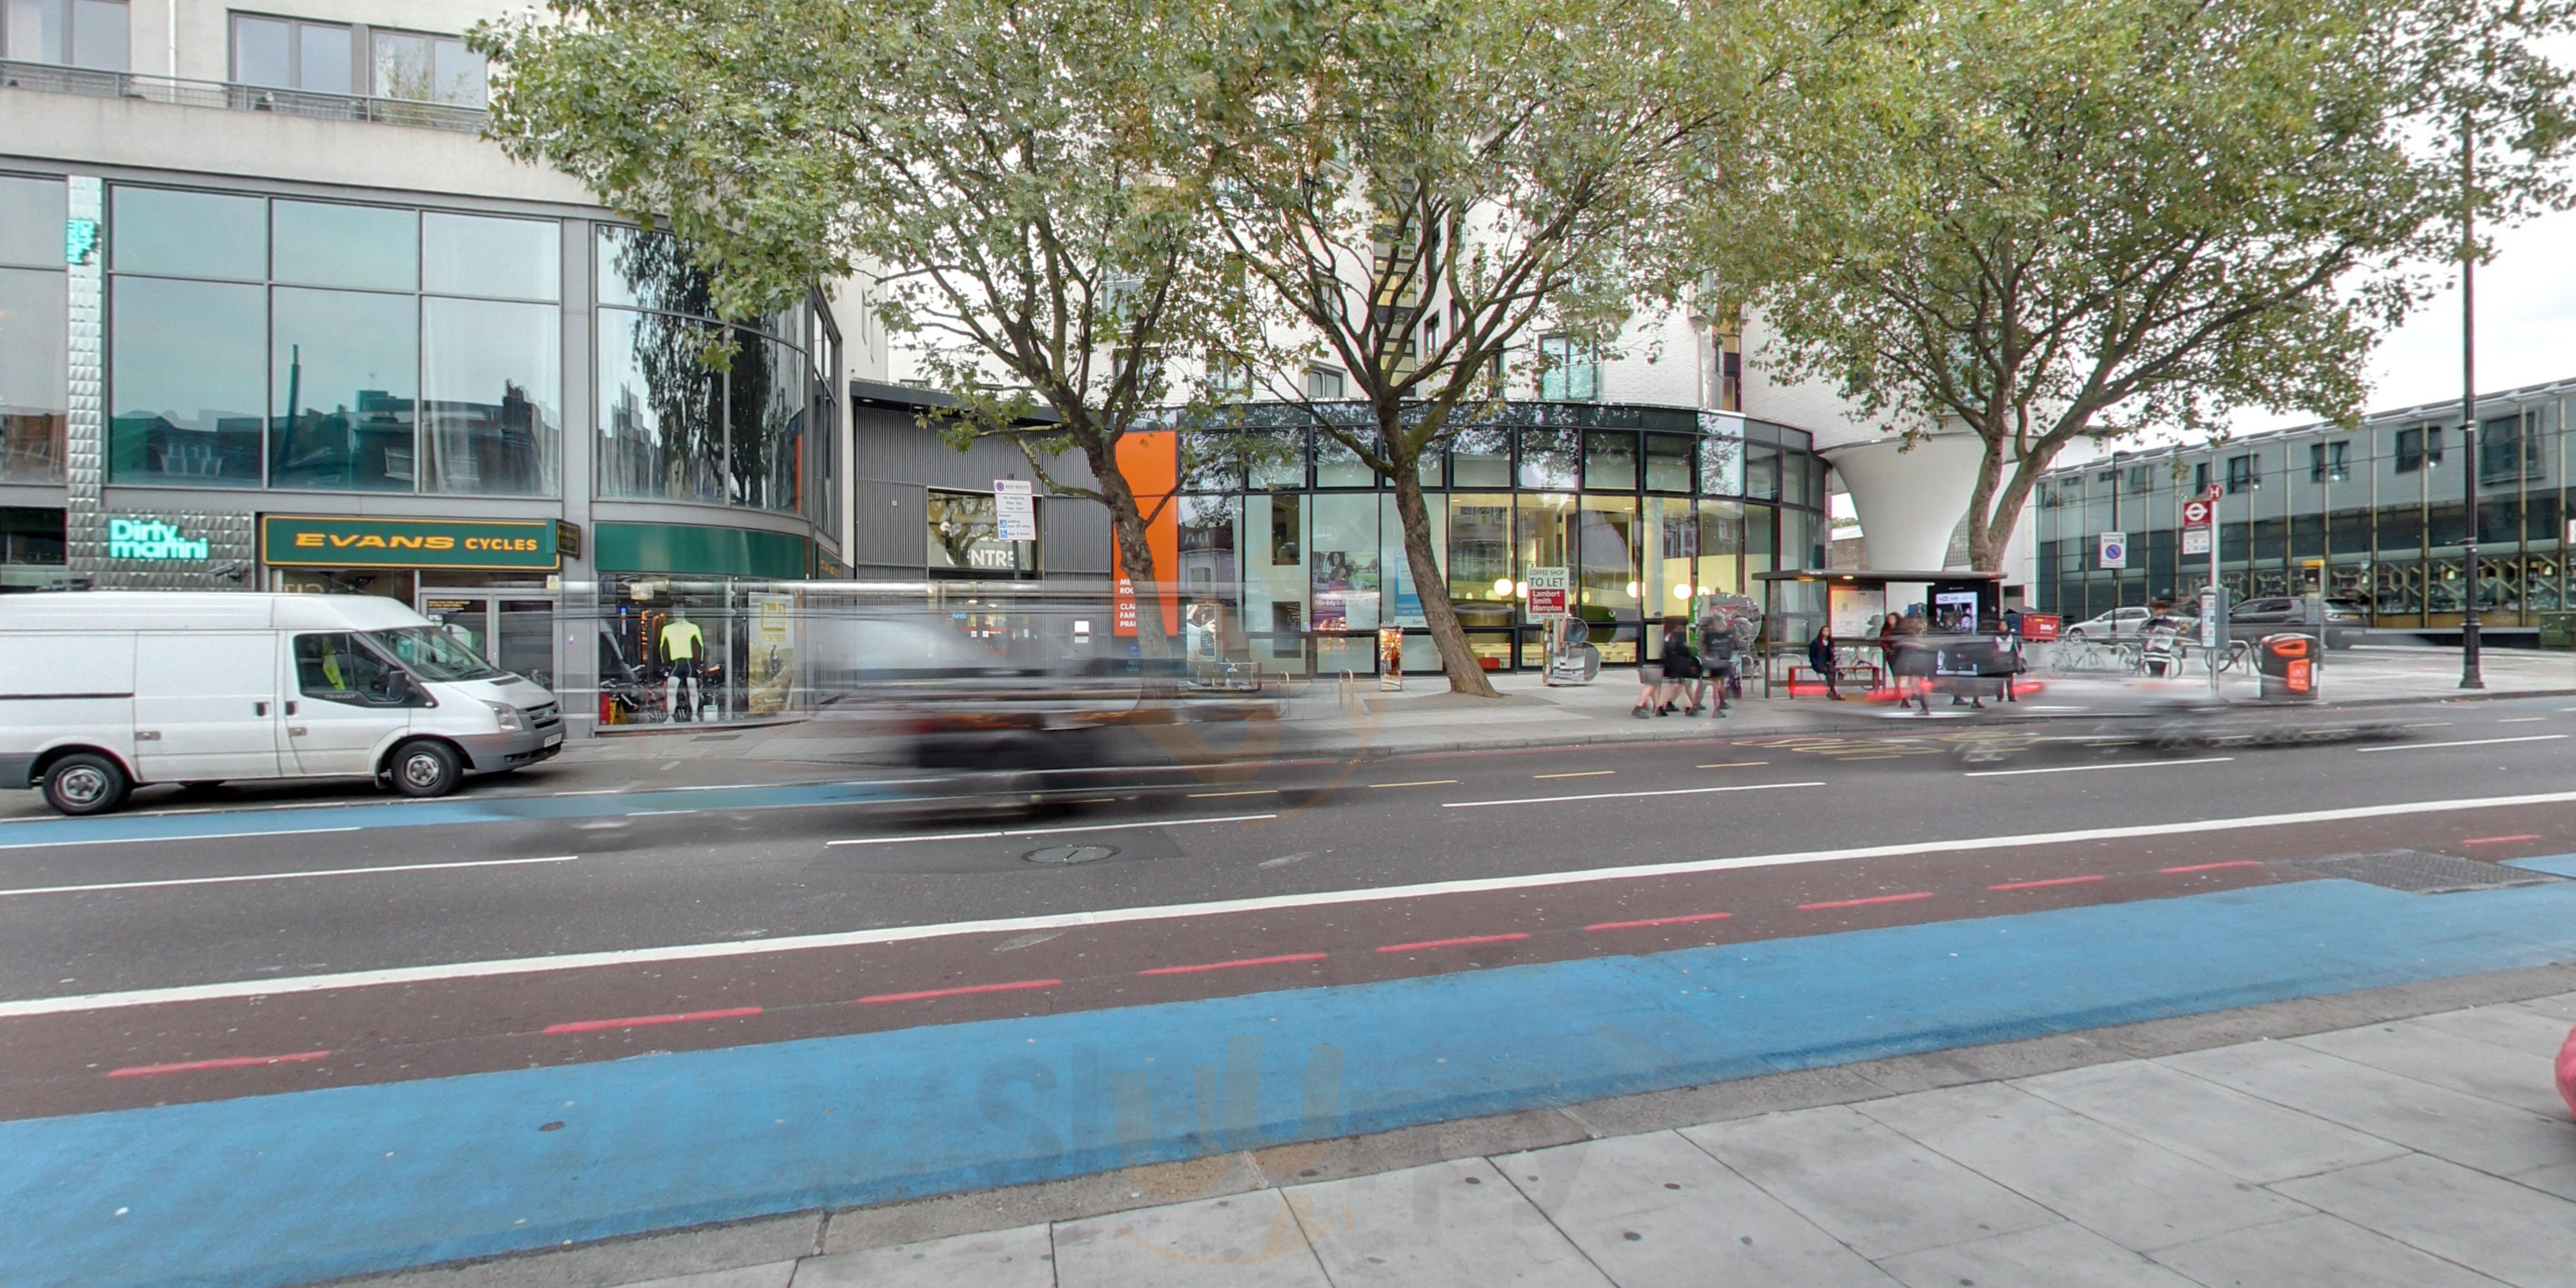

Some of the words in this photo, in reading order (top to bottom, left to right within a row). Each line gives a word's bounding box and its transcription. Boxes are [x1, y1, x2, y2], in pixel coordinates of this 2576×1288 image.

[2210, 488, 2219, 497] H
[110, 519, 178, 541] Dirty
[111, 538, 208, 558] martini
[295, 533, 455, 549] EVANS
[465, 537, 538, 551] CYCLES
[1529, 578, 1543, 587] TO
[1547, 578, 1564, 587] LET
